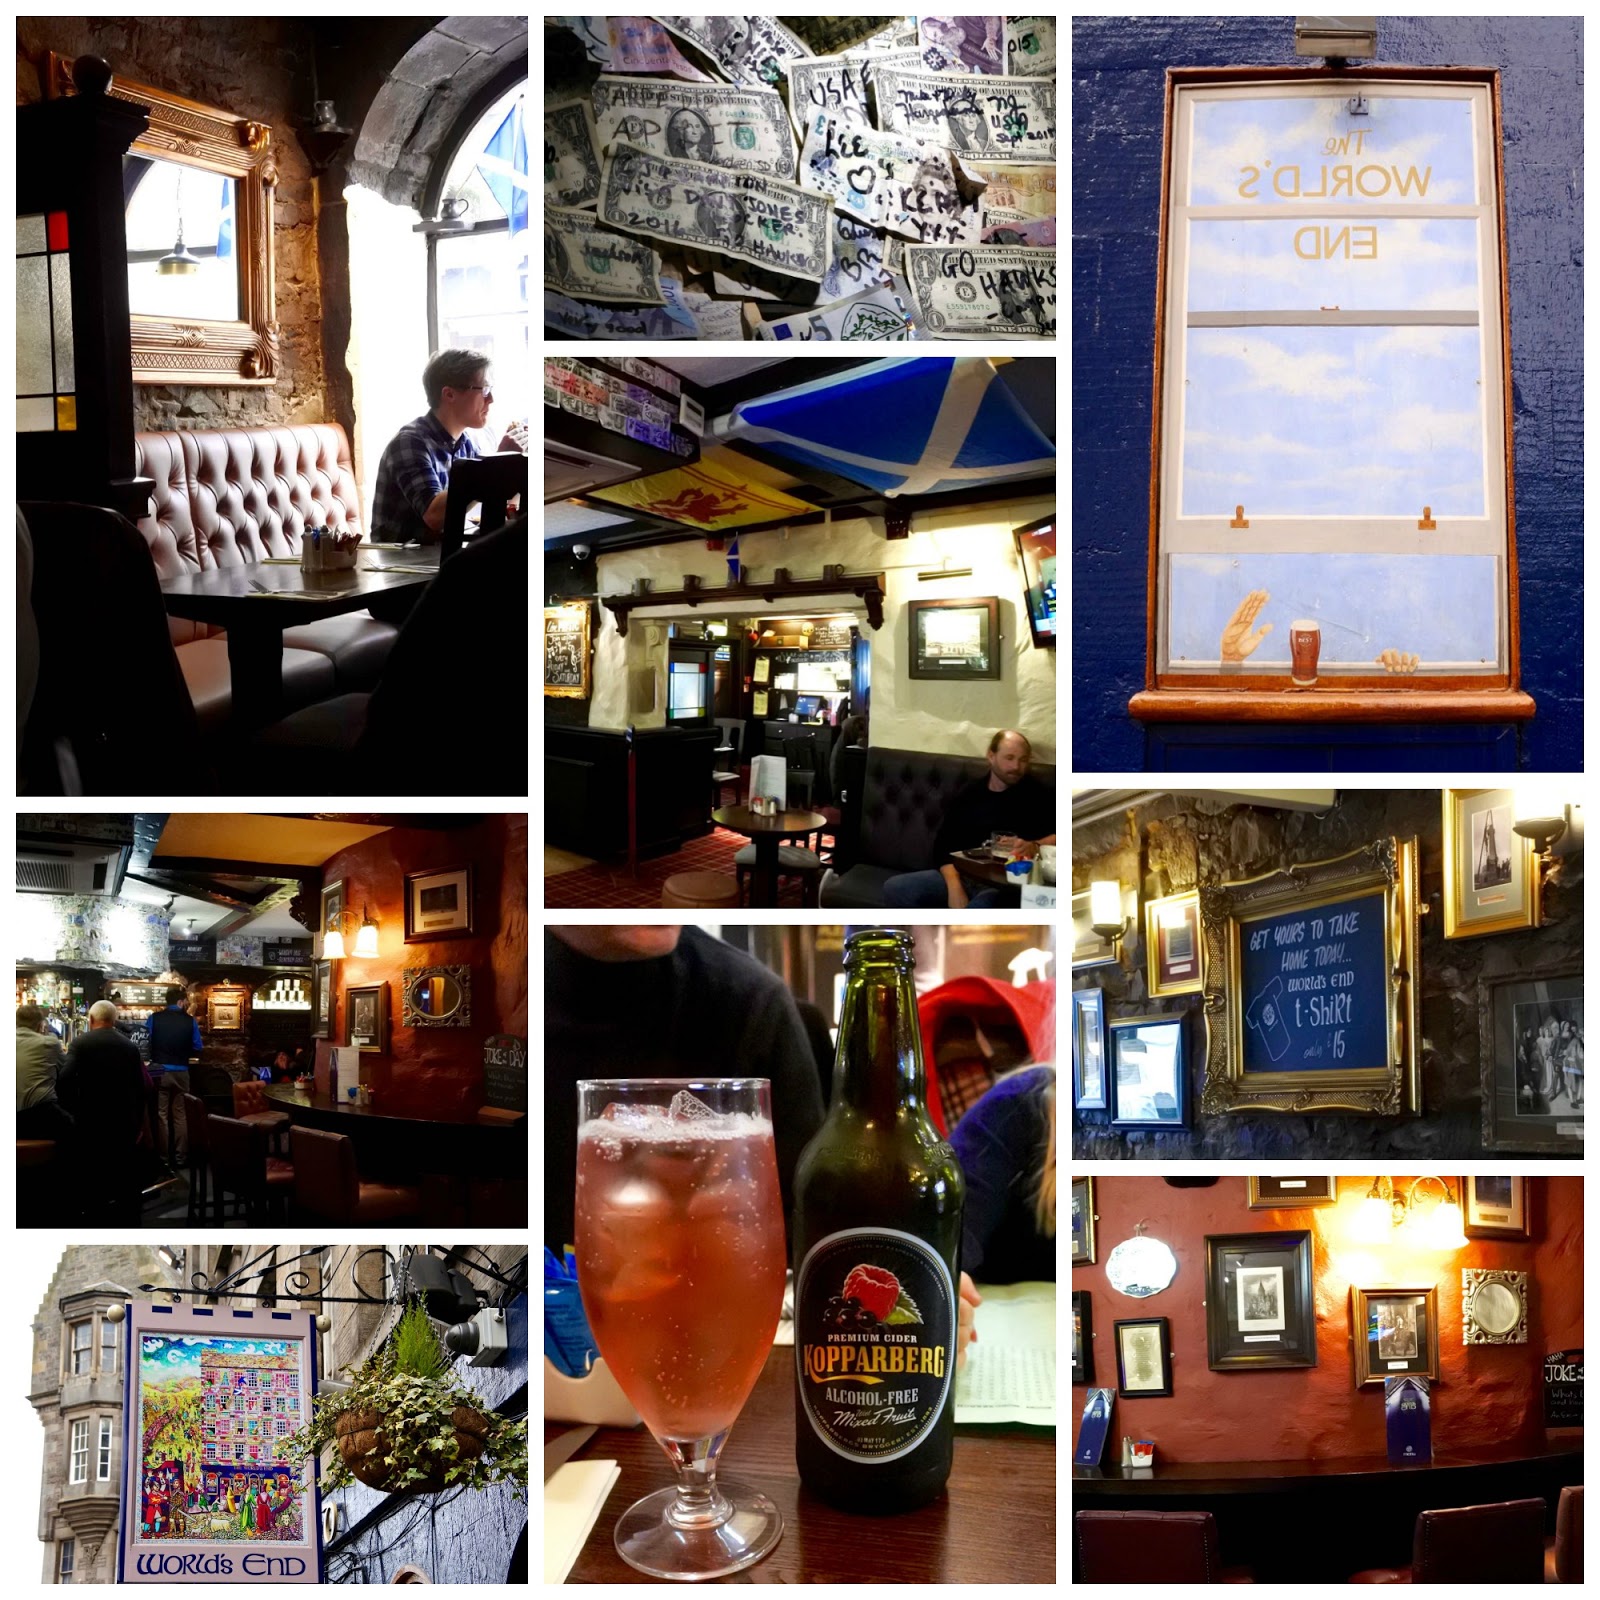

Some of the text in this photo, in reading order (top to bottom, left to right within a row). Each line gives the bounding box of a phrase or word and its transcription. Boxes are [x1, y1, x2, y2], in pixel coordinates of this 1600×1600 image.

[991, 87, 1029, 97] AMERICA
[941, 250, 975, 279] GO
[979, 265, 1056, 300] HAWKS
[1250, 911, 1360, 951] GET YOURS TO TAKE
[1281, 948, 1309, 972] HOME
[484, 1047, 502, 1065] JOKE
[509, 1050, 527, 1068] DAY
[828, 1334, 917, 1343] PREMIUM CIDER
[803, 1344, 945, 1381] KOPPARBERG
[1544, 1364, 1576, 1383] JOKE
[826, 1387, 919, 1406] ALCOHOL-FREE
[833, 1411, 878, 1428] Mixed
[874, 1407, 916, 1426] Fruit
